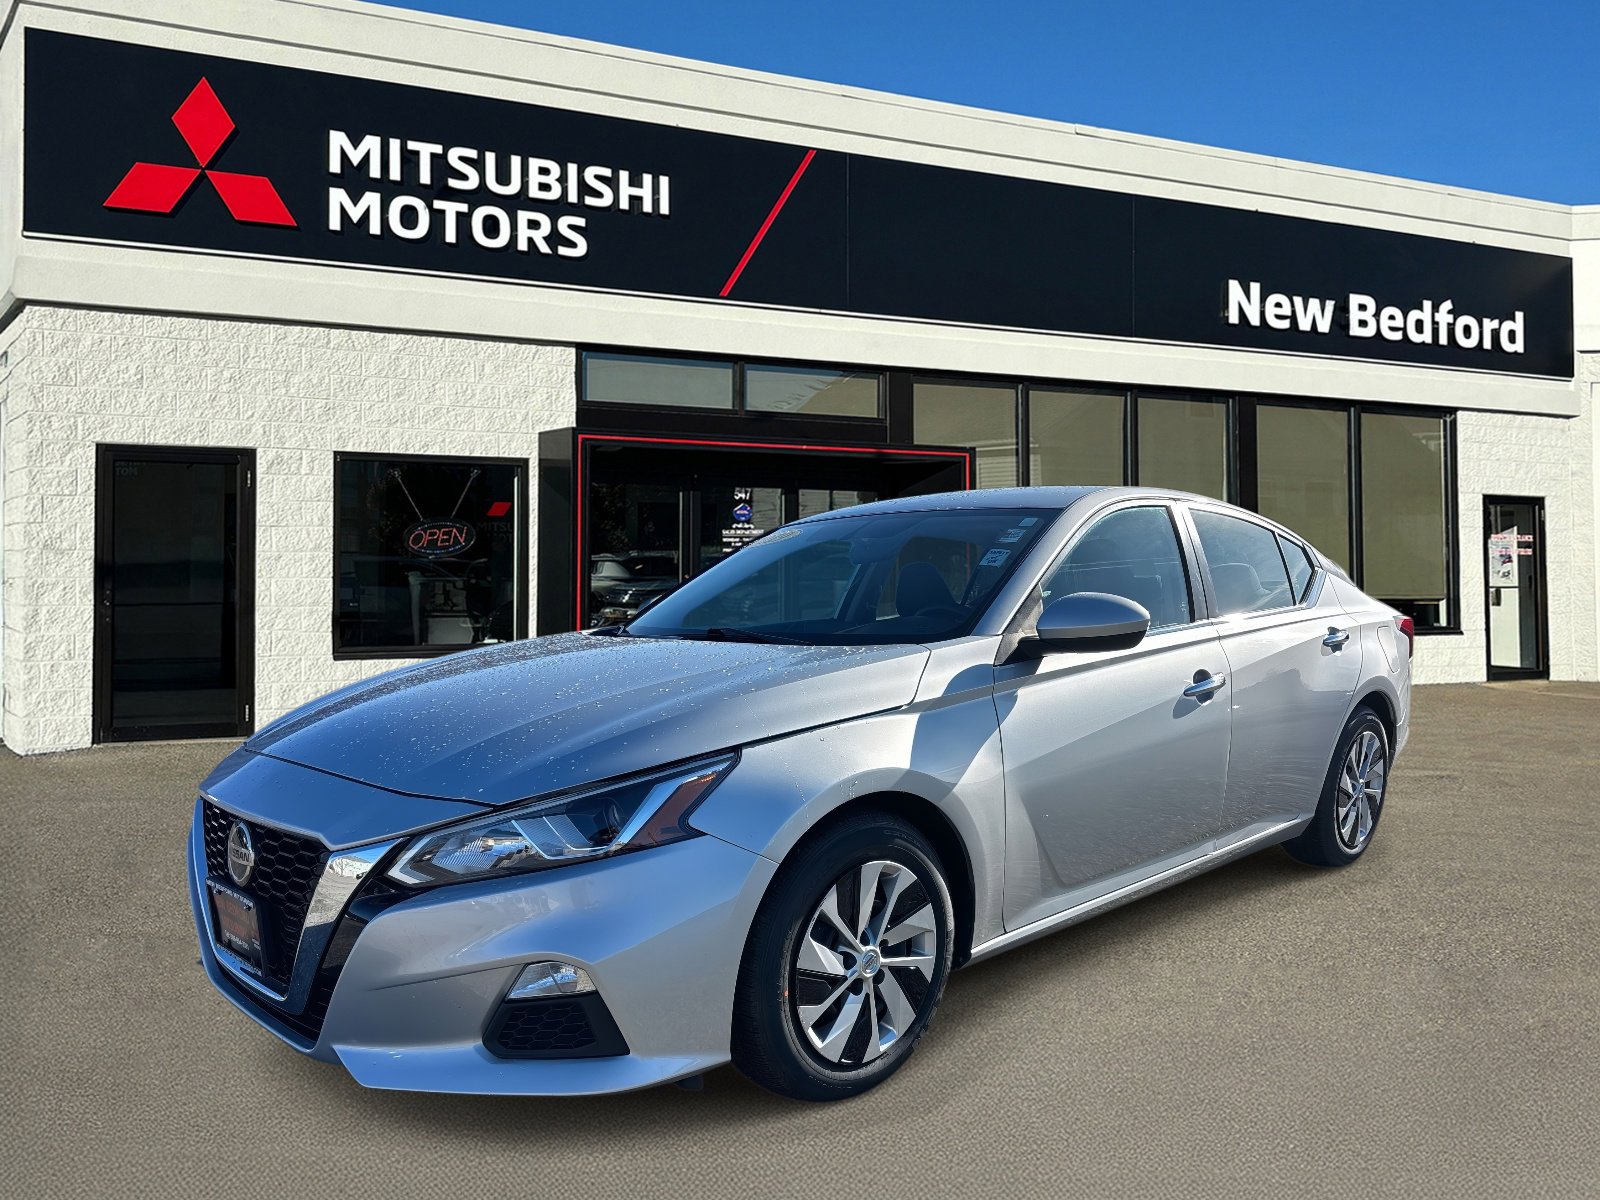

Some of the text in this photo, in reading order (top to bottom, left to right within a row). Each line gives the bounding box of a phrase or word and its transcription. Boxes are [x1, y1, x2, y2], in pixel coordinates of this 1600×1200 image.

[327, 129, 671, 216] MITSUBISHI
[327, 187, 589, 258] MOTORS
[1227, 279, 1525, 354] New Bedford
[734, 488, 751, 500] 547
[409, 526, 468, 549] OPEN
